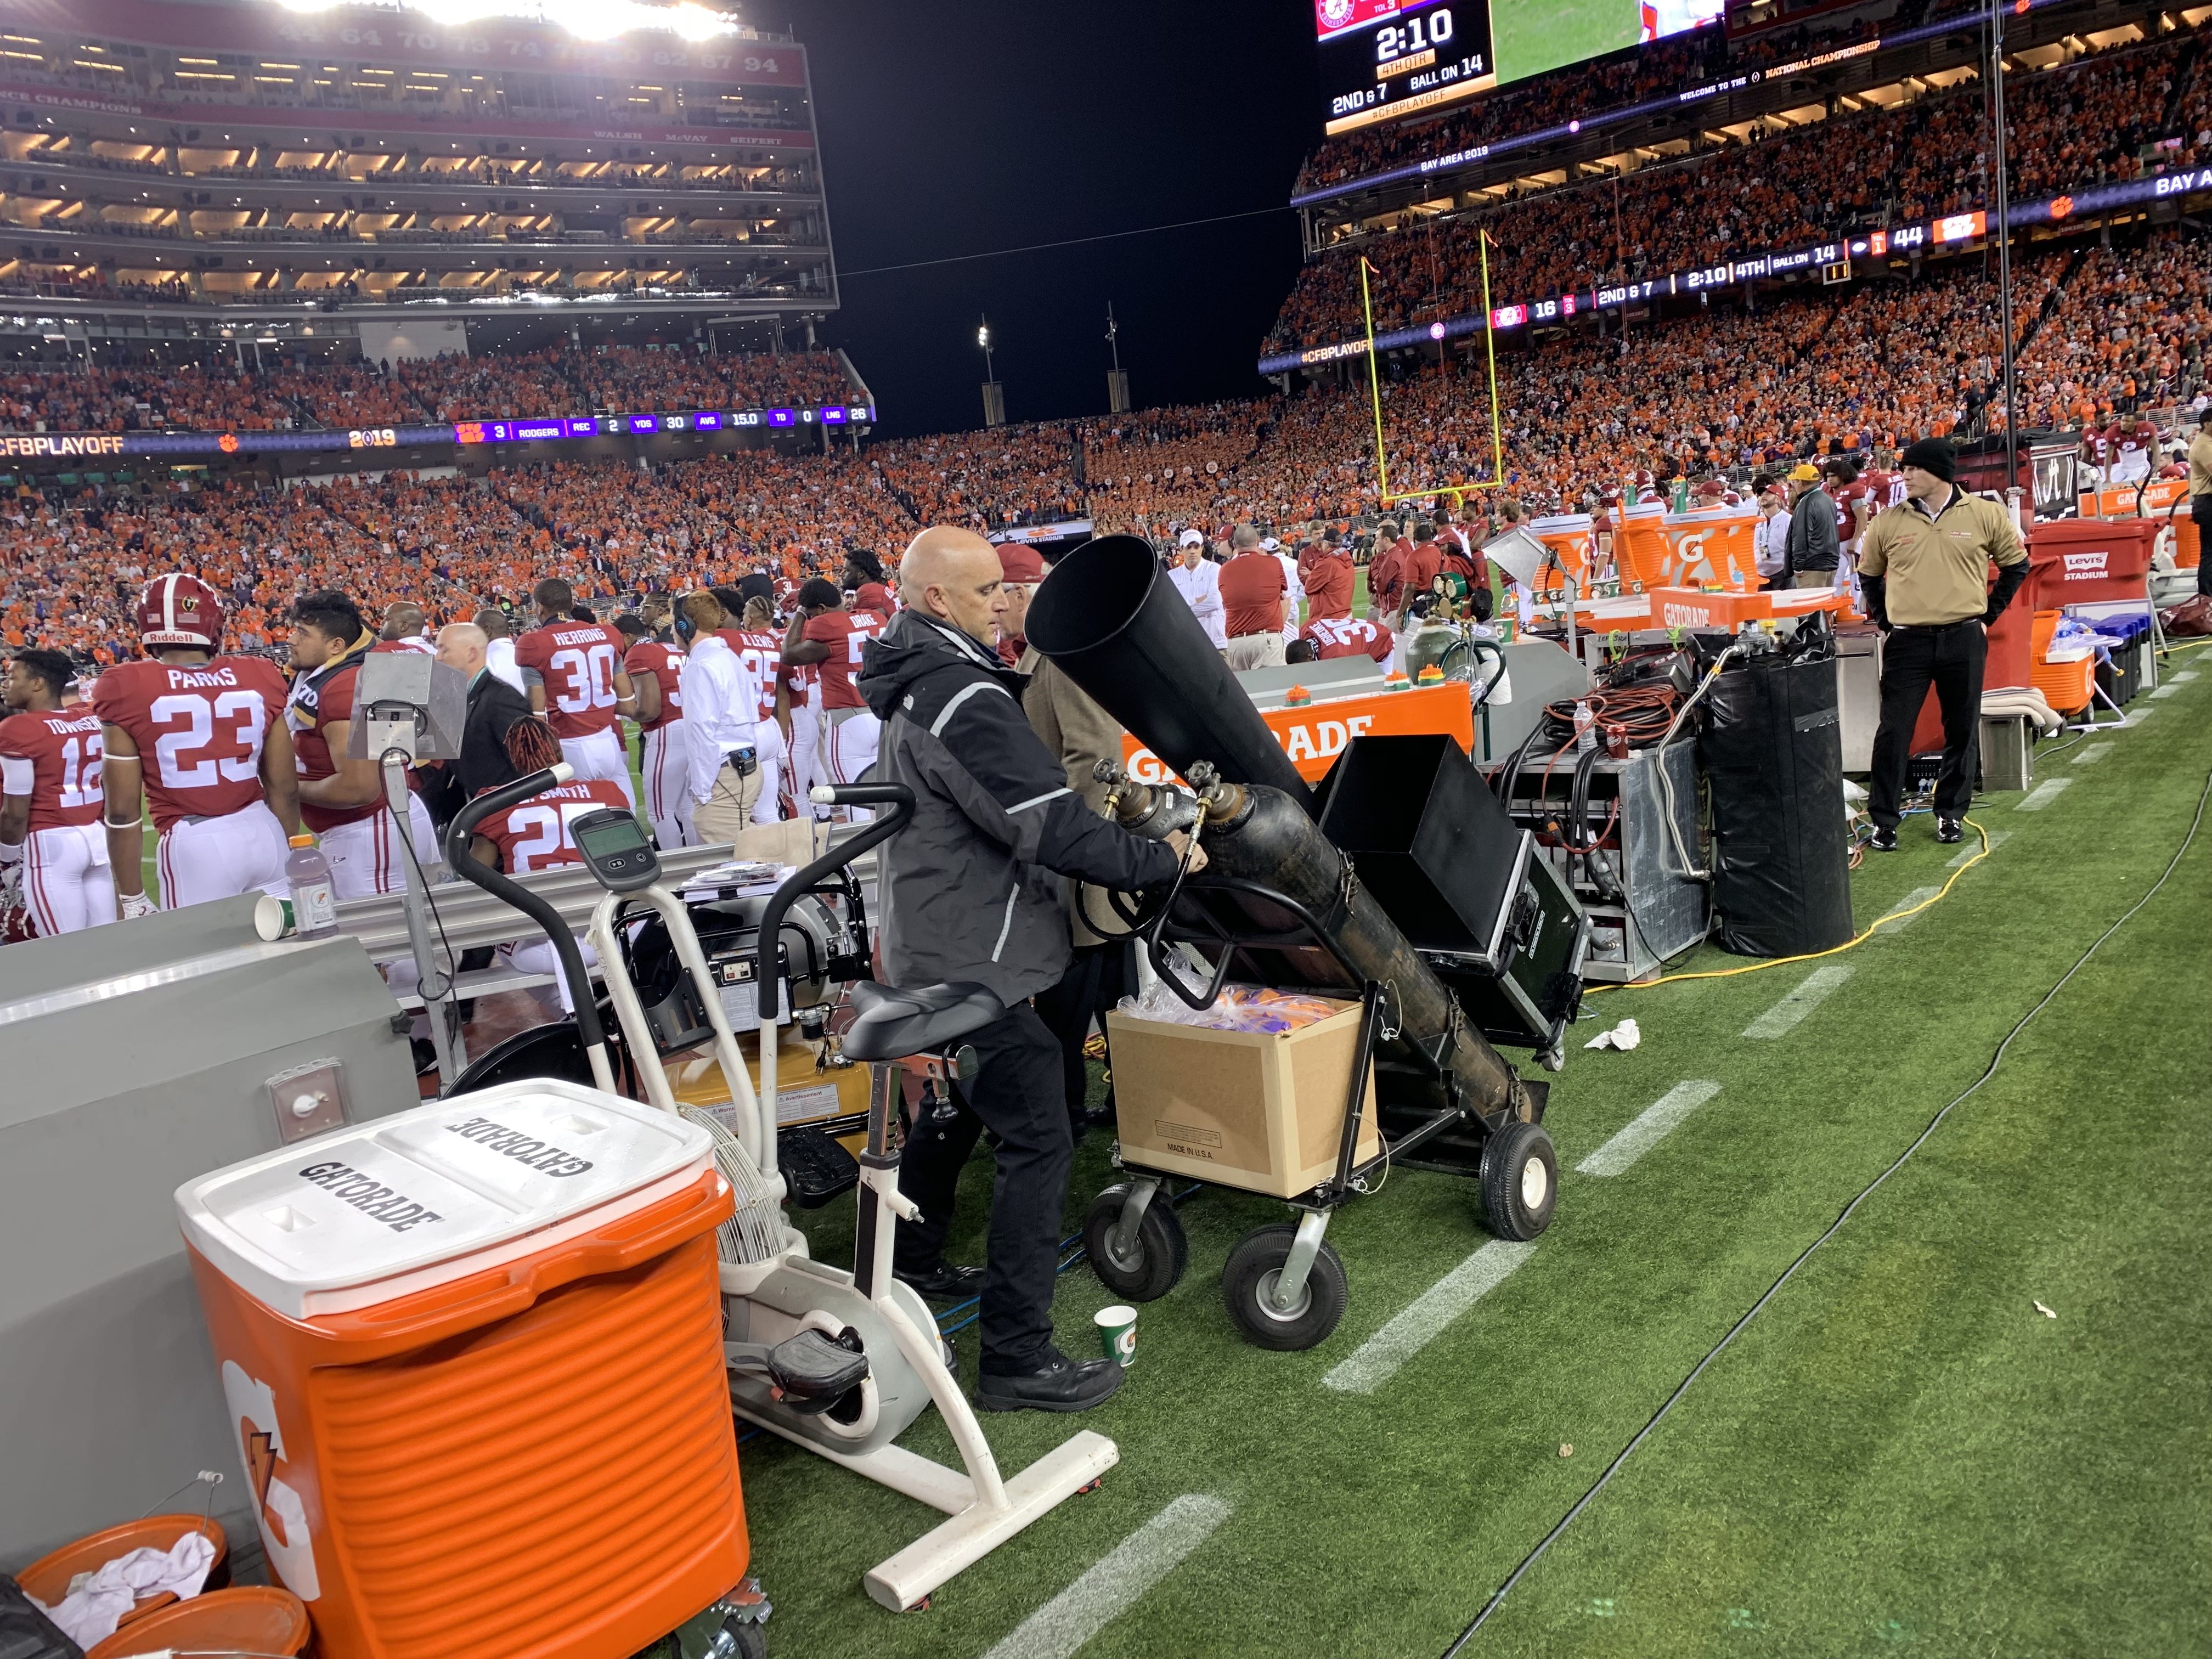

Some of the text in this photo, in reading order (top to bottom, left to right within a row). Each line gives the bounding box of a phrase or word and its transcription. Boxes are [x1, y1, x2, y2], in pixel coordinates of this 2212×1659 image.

[1374, 0, 1396, 13] TOL 3
[1376, 8, 1453, 61] 2:10
[339, 28, 383, 46] 64
[397, 31, 437, 50] 70
[744, 57, 778, 74] 94
[1382, 53, 1427, 75] 4TH QTR
[1410, 53, 1483, 90] BALL ON 14
[1679, 40, 1881, 101] WELCOME TO THE NATIONAL CHAMPIONSHIP
[1333, 82, 1387, 114] 2ND & 7
[1372, 90, 1446, 119] #CFBPLAYOFF
[593, 131, 782, 145] WALSH McVAY SEIFERT
[1421, 145, 1489, 172] BAY AREA 2019
[2157, 172, 2195, 194] BAY
[1874, 242, 1881, 252] 1
[1894, 226, 1923, 247] 44
[1773, 244, 1836, 269] BALL ON 14
[1688, 259, 1765, 287] 2:10 4TH
[1598, 281, 1653, 305] 2ND & 7
[1536, 300, 1556, 318] 16
[1565, 303, 1573, 312] 3
[494, 408, 866, 438] 3 RODGERS REC 2 YDS 30 AVG 15.0 TD 0 LNG 26
[349, 428, 395, 448] 2019
[2096, 438, 2107, 458] 5
[1039, 534, 1064, 543] STADIUM
[1678, 533, 1703, 562] G
[2064, 571, 2108, 581] STADIUM
[849, 613, 878, 629] DRAKE
[1663, 603, 1710, 627] GATORADE
[150, 634, 193, 642] Riddell
[552, 628, 607, 646] HERRING
[740, 634, 752, 646] R.
[752, 635, 775, 649] LEWIS
[167, 667, 238, 690] PARKS
[550, 644, 618, 713] 30
[150, 690, 266, 788] 23
[59, 734, 104, 808] 12
[539, 784, 591, 800] SMITH
[785, 1091, 822, 1102] Avertissement
[452, 1117, 594, 1177] GATORADE
[1167, 1143, 1215, 1160] MADE IN U.S.A.
[298, 1161, 443, 1233] GATORADE
